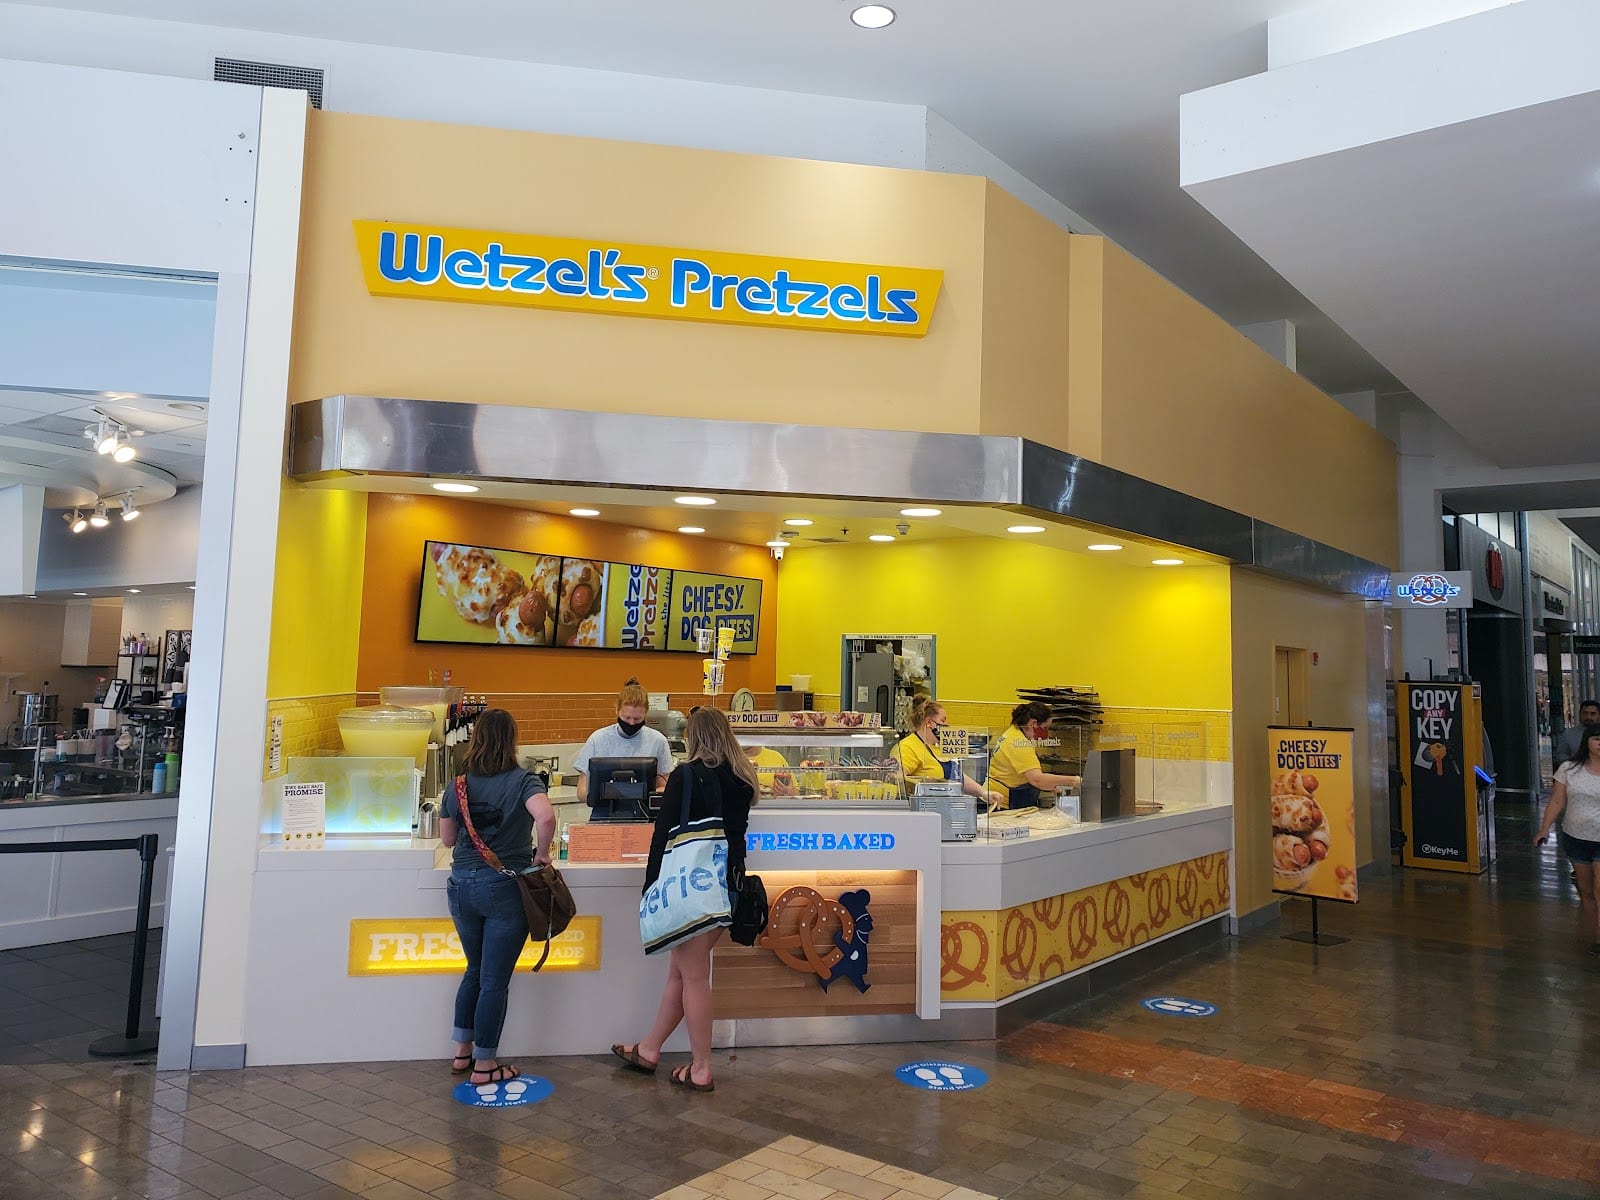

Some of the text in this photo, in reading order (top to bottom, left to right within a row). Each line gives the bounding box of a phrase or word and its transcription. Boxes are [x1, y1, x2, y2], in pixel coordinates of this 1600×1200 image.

[671, 258, 919, 323] Pretzels
[1411, 689, 1458, 711] COPY
[742, 714, 758, 723] DOG
[1426, 709, 1443, 717] ANY
[1417, 717, 1453, 739] KEY
[942, 746, 966, 754] SAFE
[1279, 740, 1327, 753] CHEESY
[1277, 754, 1336, 769] DOG BITES
[284, 788, 323, 797] PROMISE
[746, 833, 895, 850] FRESH BAKED
[1431, 846, 1459, 856] KeyMe
[368, 932, 465, 961] FRES
